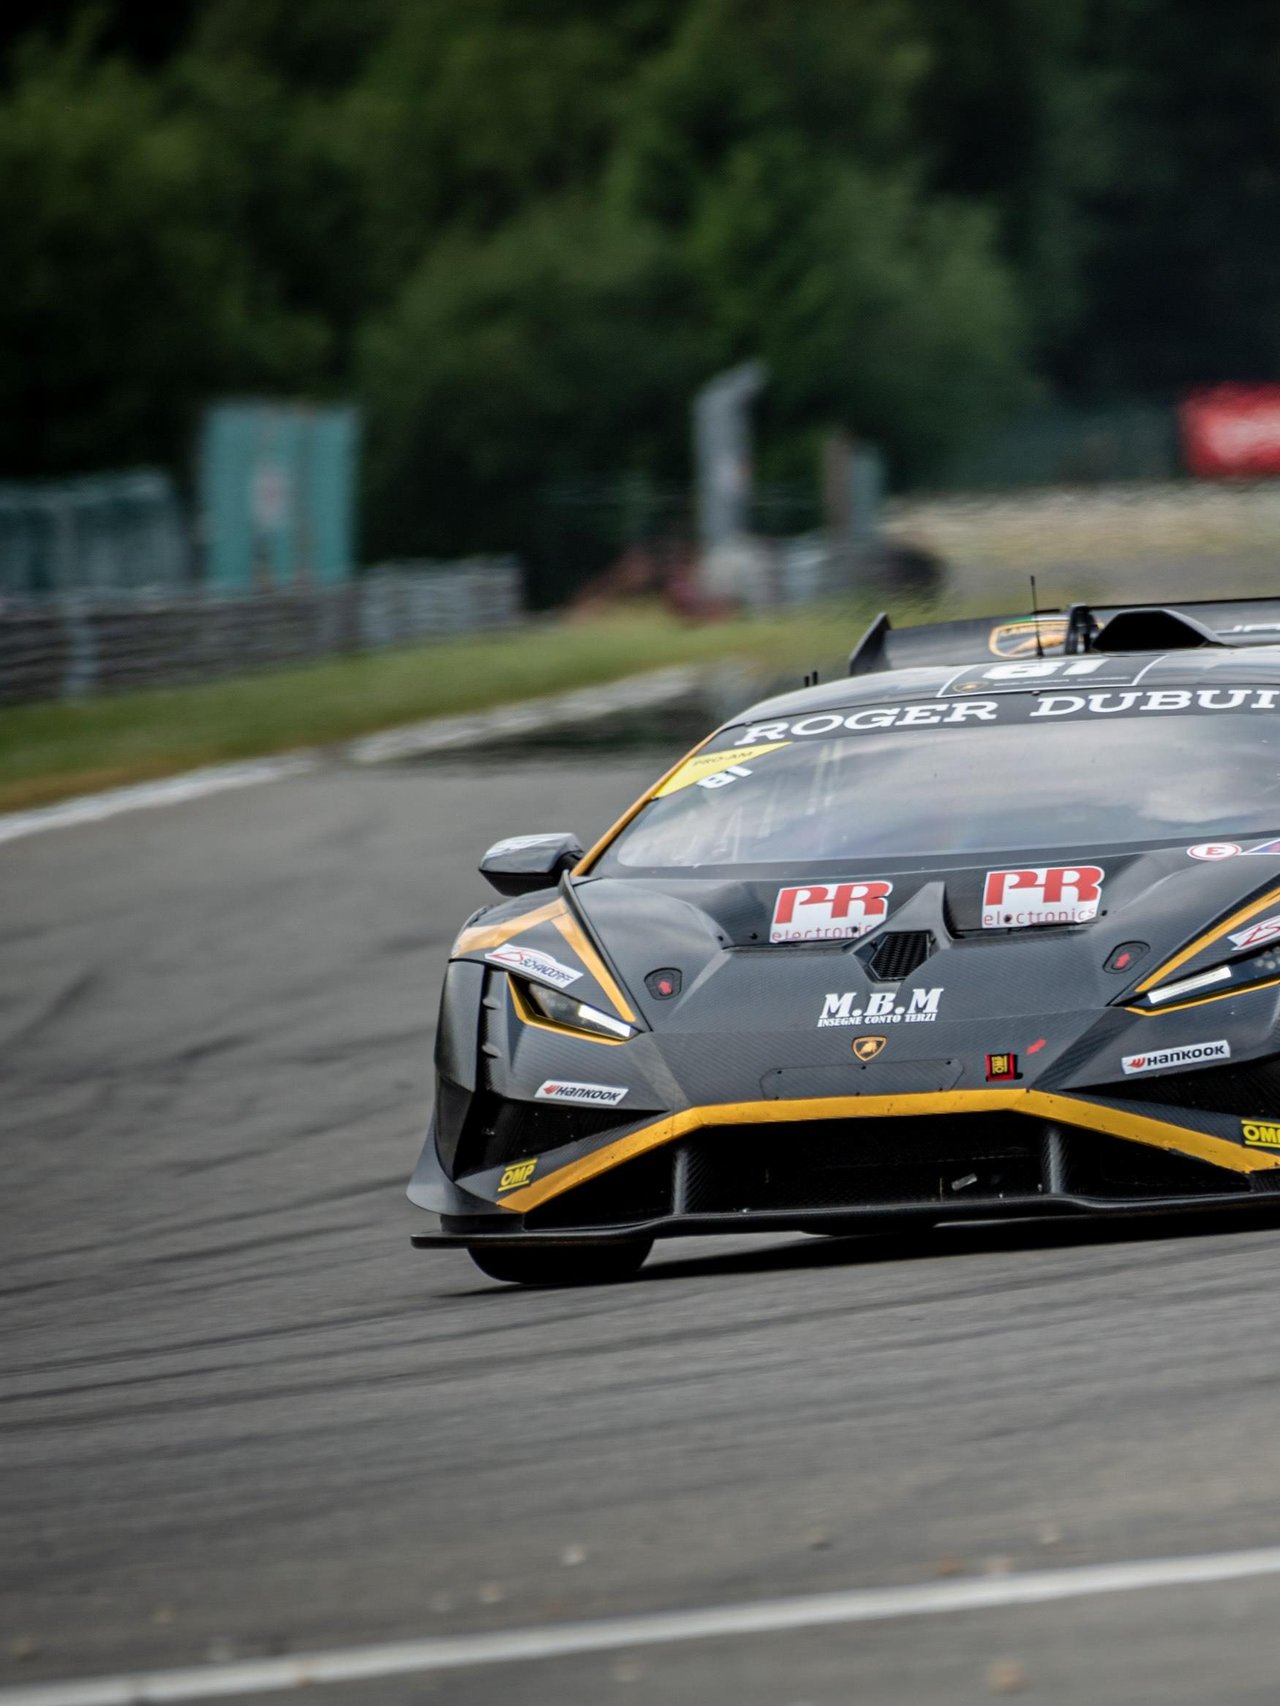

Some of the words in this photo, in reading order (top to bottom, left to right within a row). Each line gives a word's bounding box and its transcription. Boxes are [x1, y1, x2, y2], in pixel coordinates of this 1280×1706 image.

[982, 658, 1111, 680] 81
[733, 701, 999, 746] ROGER
[696, 765, 753, 789] 81
[985, 867, 1102, 906] PR
[775, 882, 890, 924] PR
[819, 987, 945, 1018] M.B.M
[817, 1016, 863, 1028] INSEGNE
[864, 1014, 902, 1025] CONTO
[904, 1012, 937, 1023] TERZI
[500, 1163, 536, 1188] OMP
